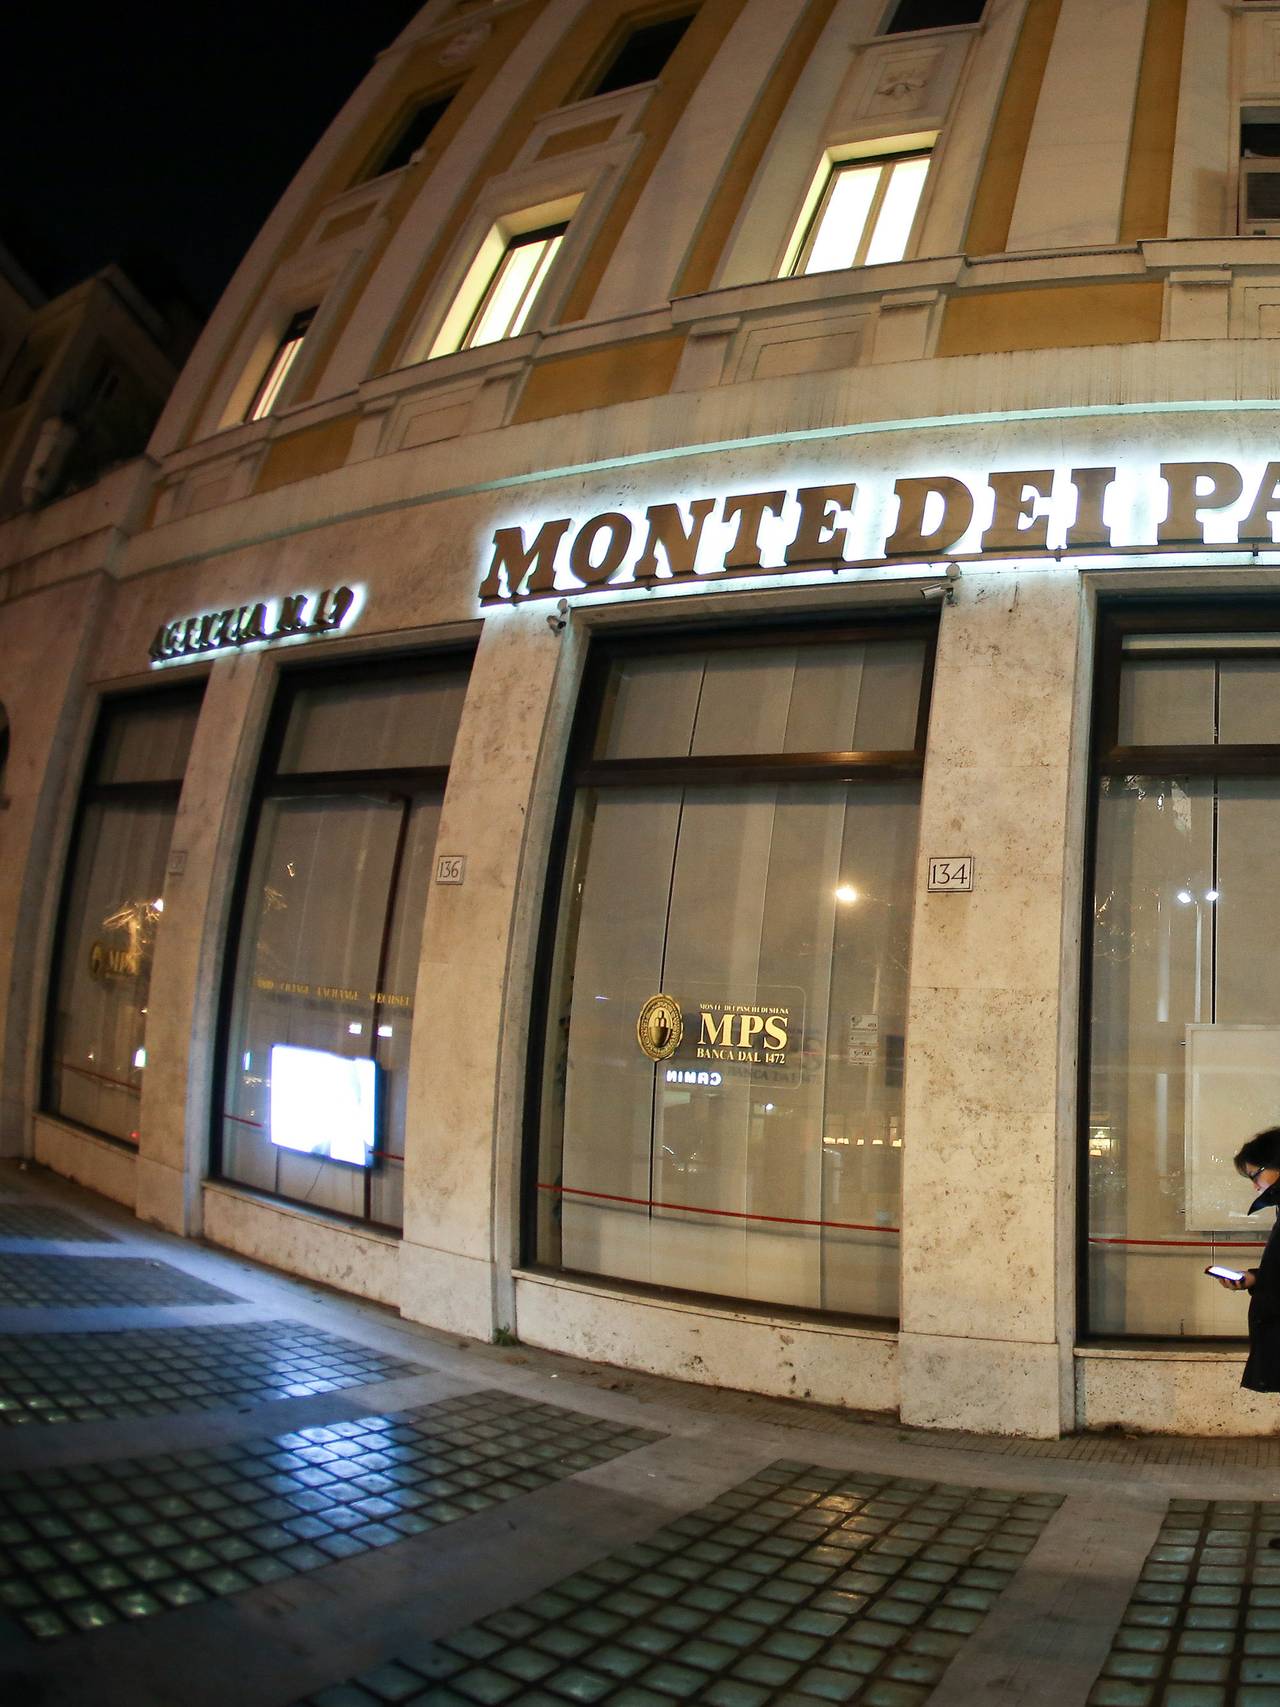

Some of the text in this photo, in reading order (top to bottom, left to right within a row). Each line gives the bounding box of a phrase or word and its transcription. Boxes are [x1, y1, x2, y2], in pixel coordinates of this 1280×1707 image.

[480, 483, 857, 602] MONTE
[885, 467, 1116, 555] DEI
[439, 860, 460, 878] 136
[932, 863, 968, 884] 134
[697, 1012, 788, 1050] MPS
[696, 1047, 785, 1064] BANCA DAL 1472
